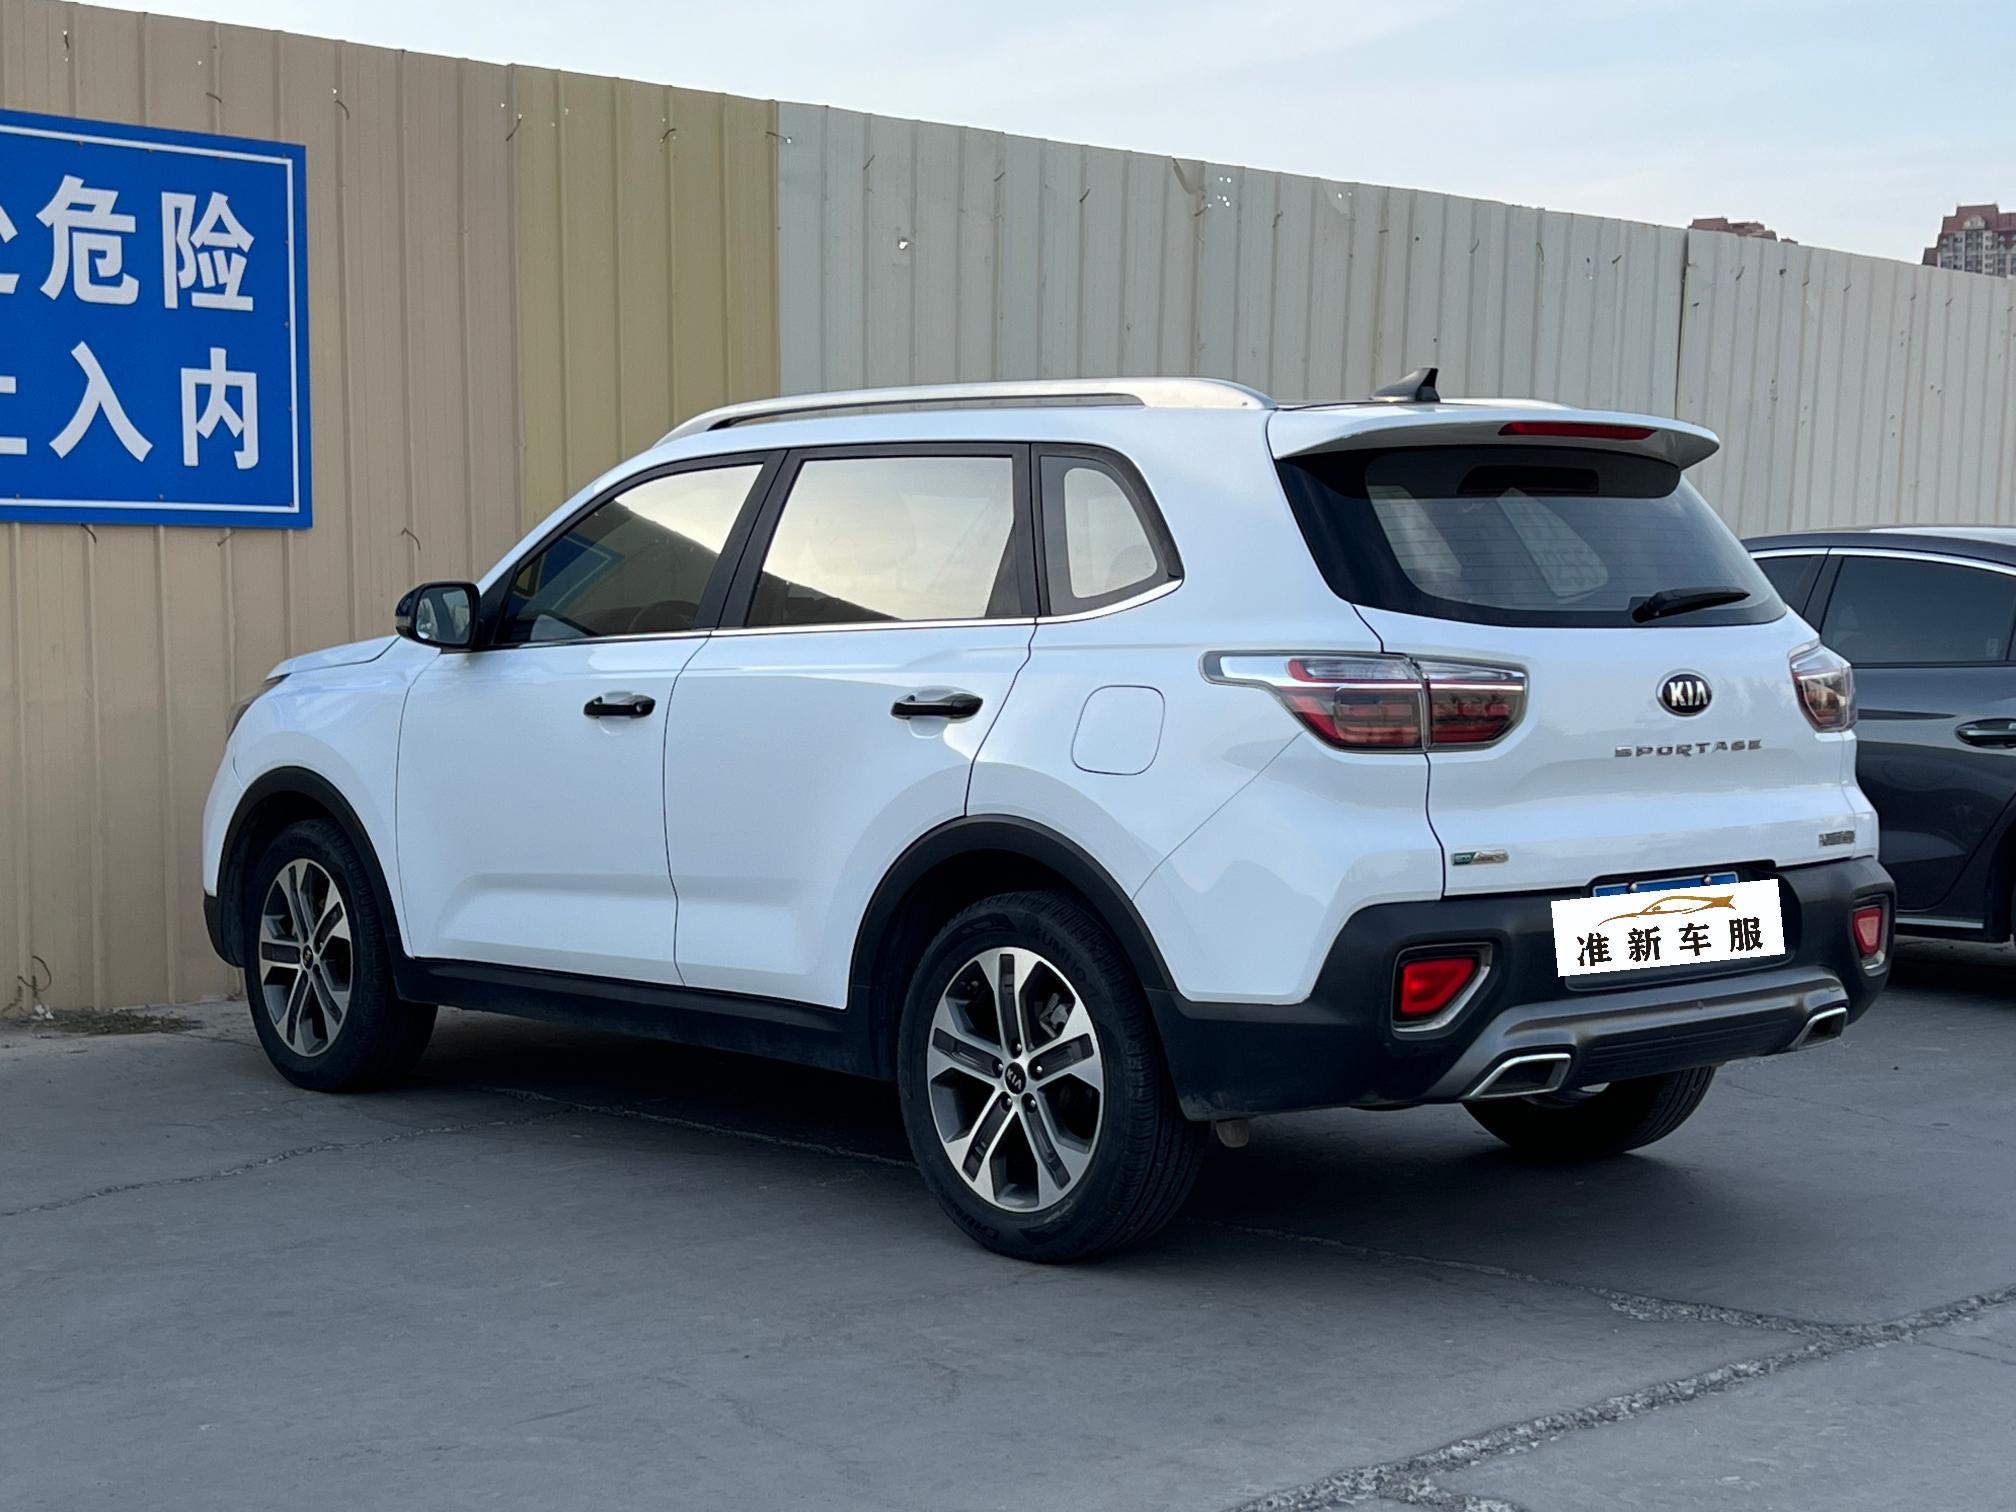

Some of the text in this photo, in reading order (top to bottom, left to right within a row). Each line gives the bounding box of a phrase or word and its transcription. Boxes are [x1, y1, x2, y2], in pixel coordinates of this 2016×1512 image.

[0, 175, 255, 311] 危险
[1668, 680, 1708, 707] KIA
[1614, 739, 1763, 758] SPORTAGE
[1006, 1067, 1022, 1091] KIA
